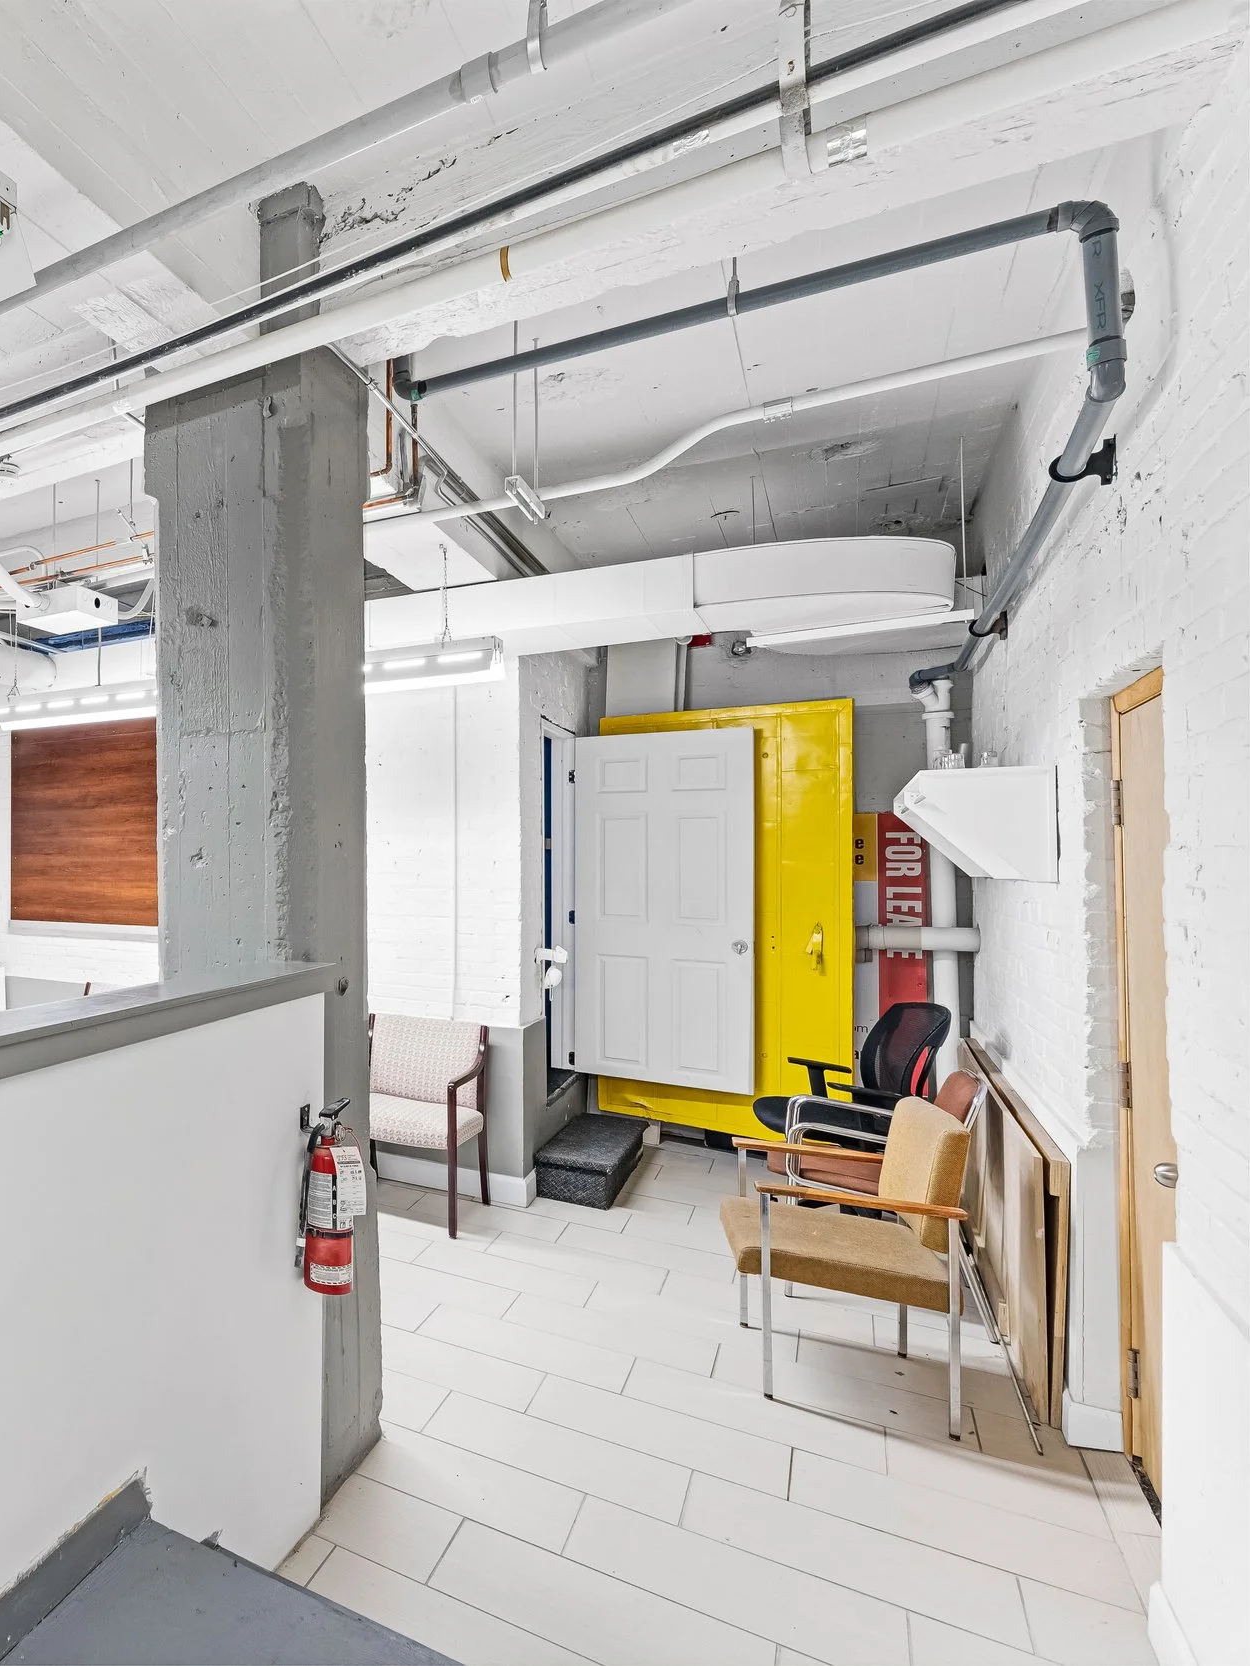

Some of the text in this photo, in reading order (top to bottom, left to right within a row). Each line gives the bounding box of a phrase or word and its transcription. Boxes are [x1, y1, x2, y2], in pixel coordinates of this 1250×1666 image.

[1094, 281, 1107, 329] XFR
[885, 831, 923, 960] FOR LEAE
